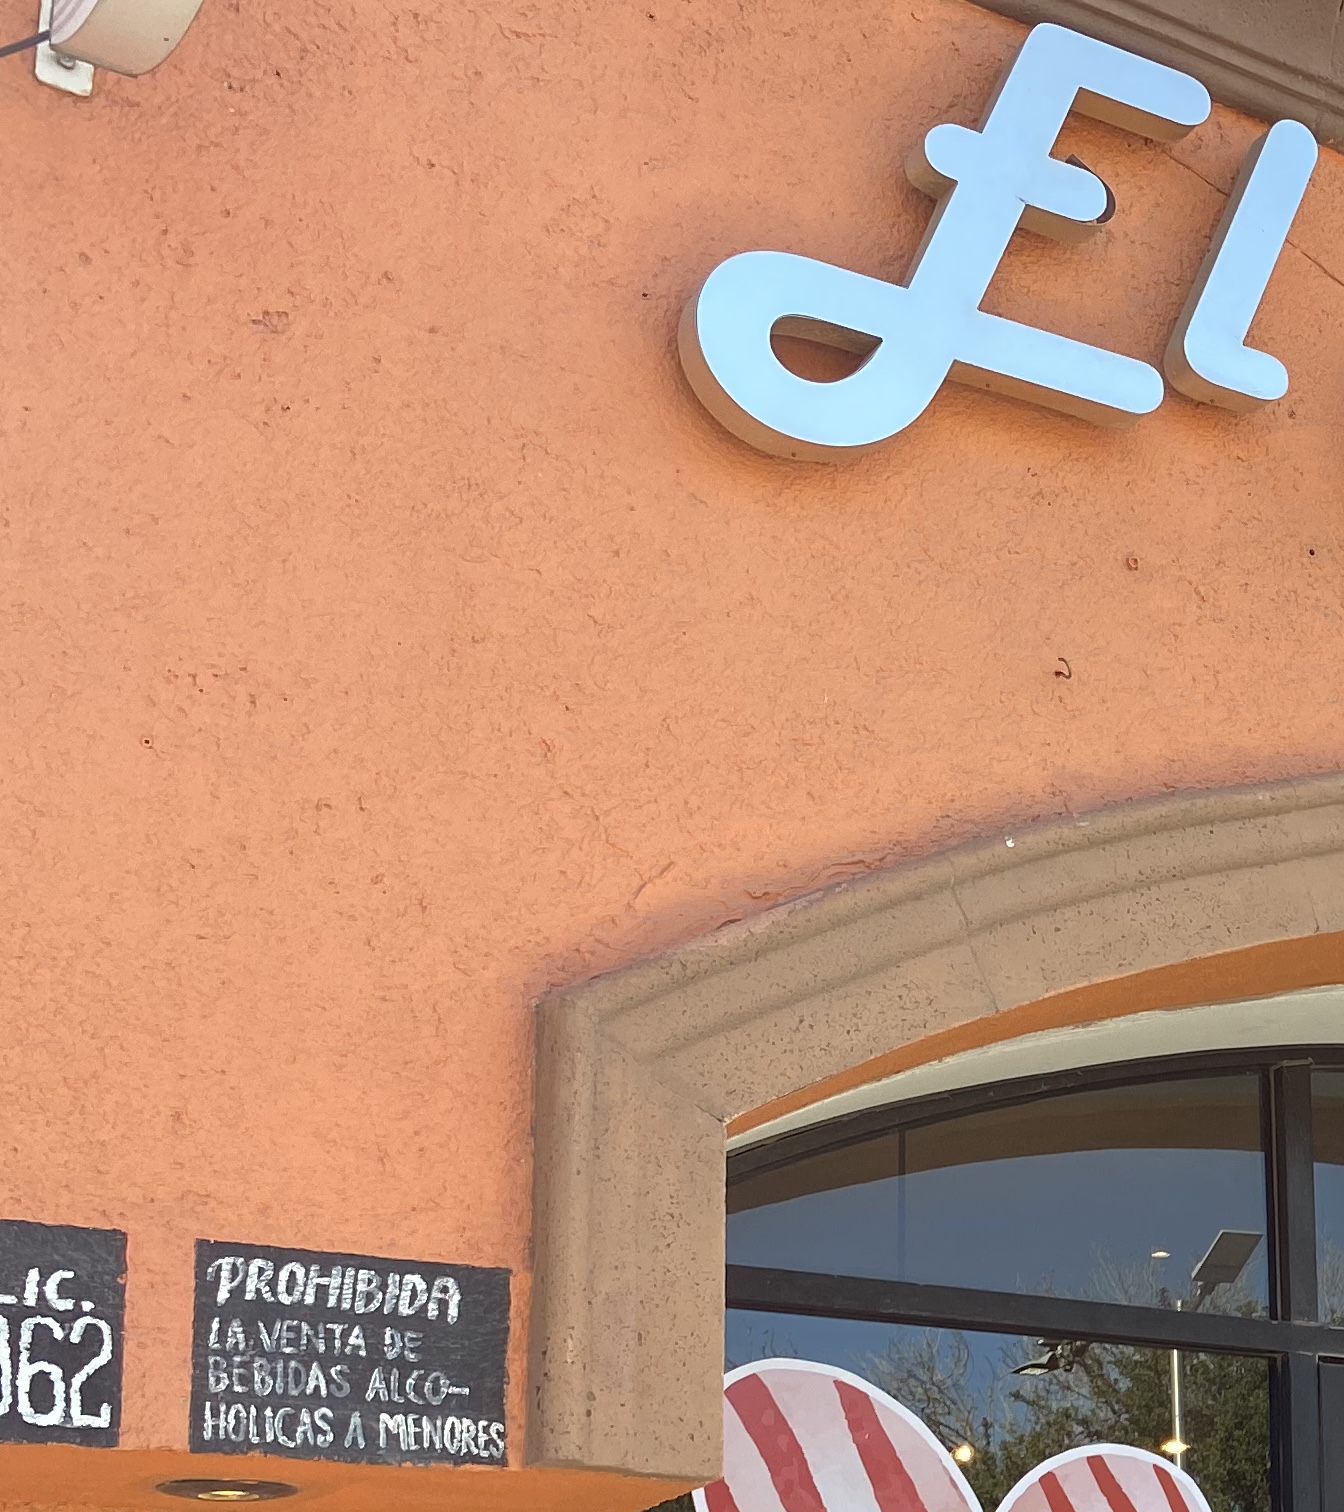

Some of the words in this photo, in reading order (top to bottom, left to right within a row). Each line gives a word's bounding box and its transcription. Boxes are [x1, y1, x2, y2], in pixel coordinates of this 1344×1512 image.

[693, 22, 1320, 450] El
[0, 1267, 95, 1312] IC.
[206, 1256, 463, 1326] PROHIBIDA
[208, 1318, 247, 1352] LA
[258, 1319, 367, 1359] VENTA
[383, 1325, 423, 1362] DE
[208, 1355, 352, 1400] BEBIDAS
[365, 1366, 471, 1406] ALCO-
[202, 1401, 335, 1450] HOLICAS
[343, 1416, 367, 1450] A
[379, 1416, 506, 1460] MENORES
